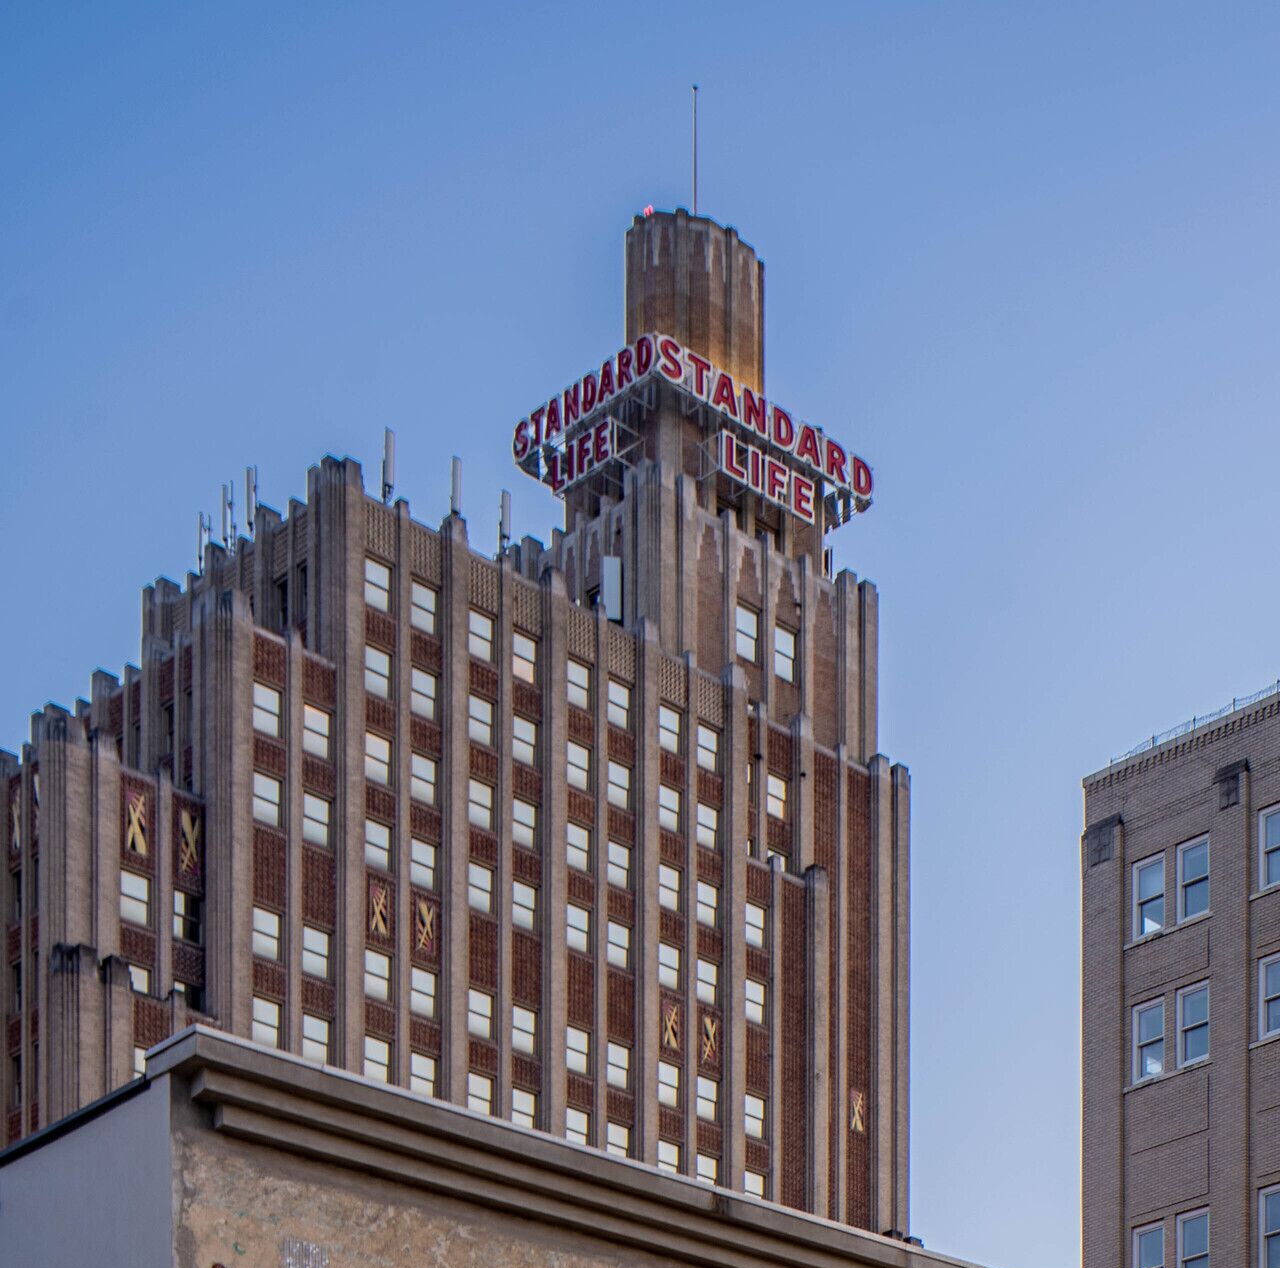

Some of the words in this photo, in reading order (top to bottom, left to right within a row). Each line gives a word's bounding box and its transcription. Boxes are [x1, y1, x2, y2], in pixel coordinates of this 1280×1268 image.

[513, 333, 655, 460] STANDARD
[656, 333, 874, 500] STANDARD
[550, 416, 613, 496] LIFE
[721, 429, 815, 525] LIFE
